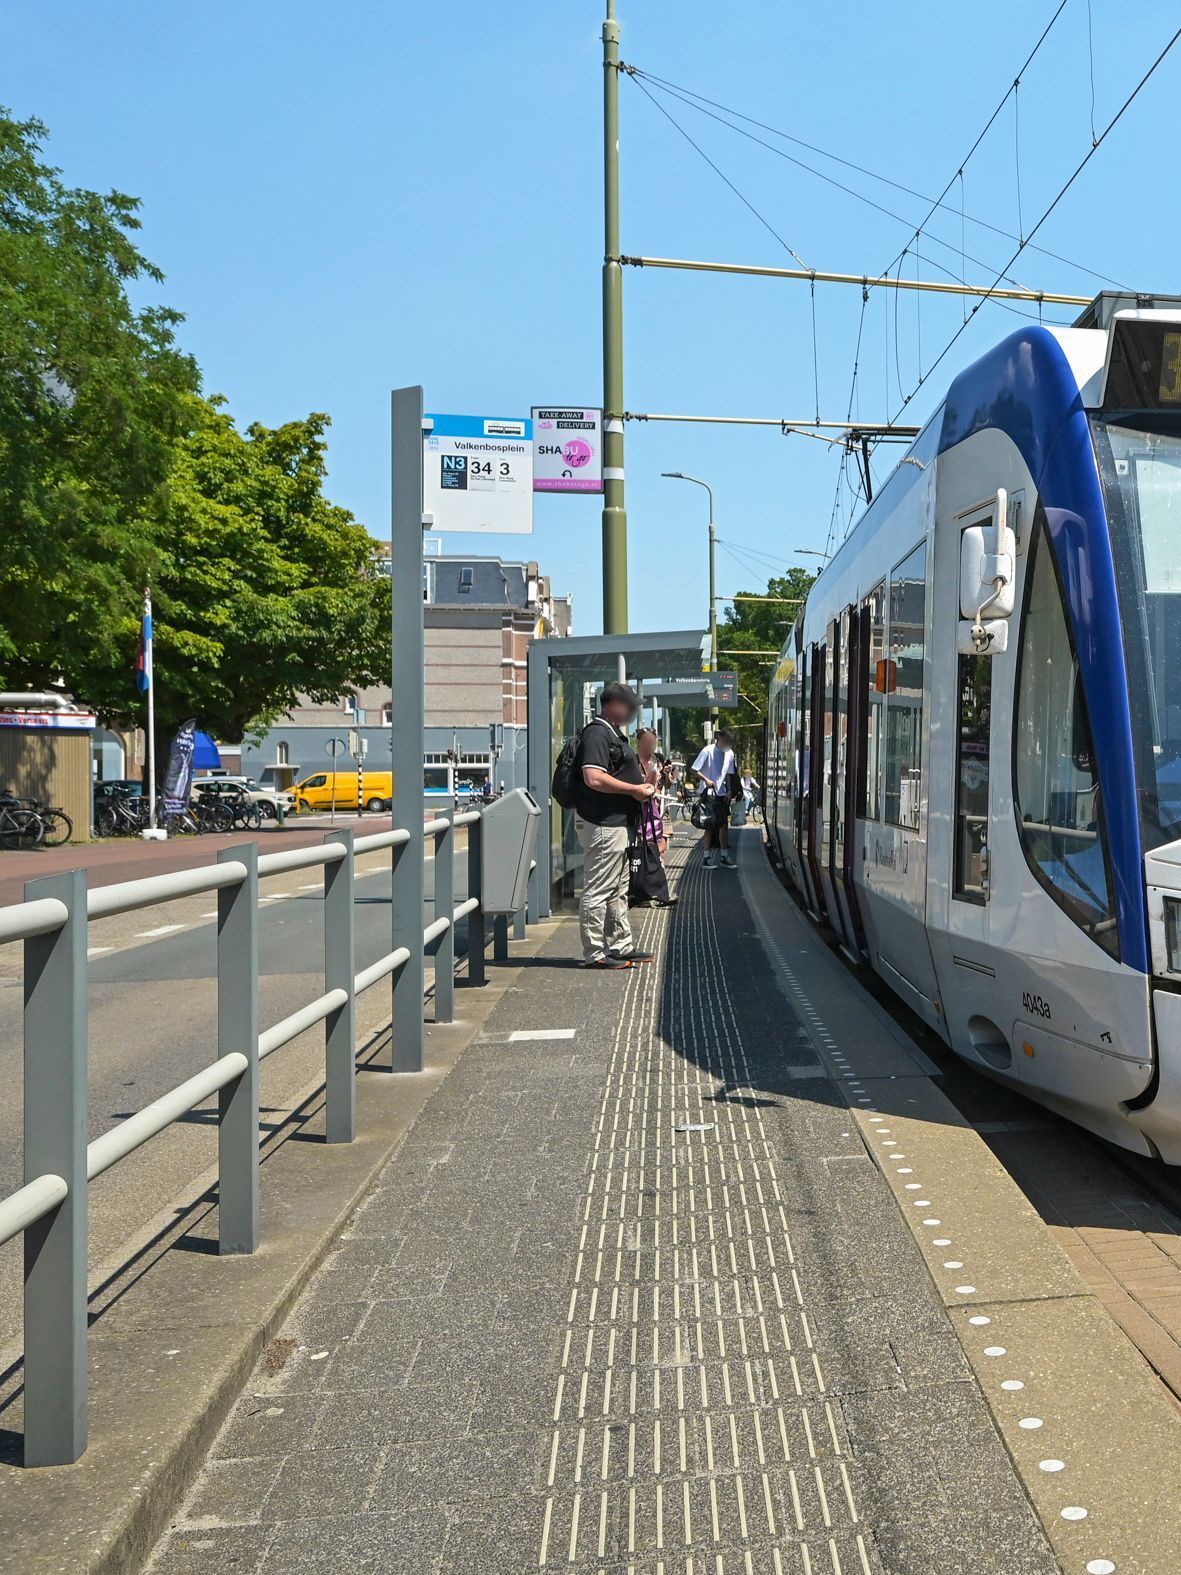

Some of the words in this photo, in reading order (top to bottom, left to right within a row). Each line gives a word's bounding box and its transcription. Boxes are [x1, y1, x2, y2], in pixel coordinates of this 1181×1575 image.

[454, 442, 525, 453] Valkenbosplein
[538, 445, 579, 455] SHABU
[443, 456, 466, 470] N3
[471, 461, 492, 475] 34
[499, 462, 510, 476] 3
[1022, 991, 1052, 1020] 4043a
